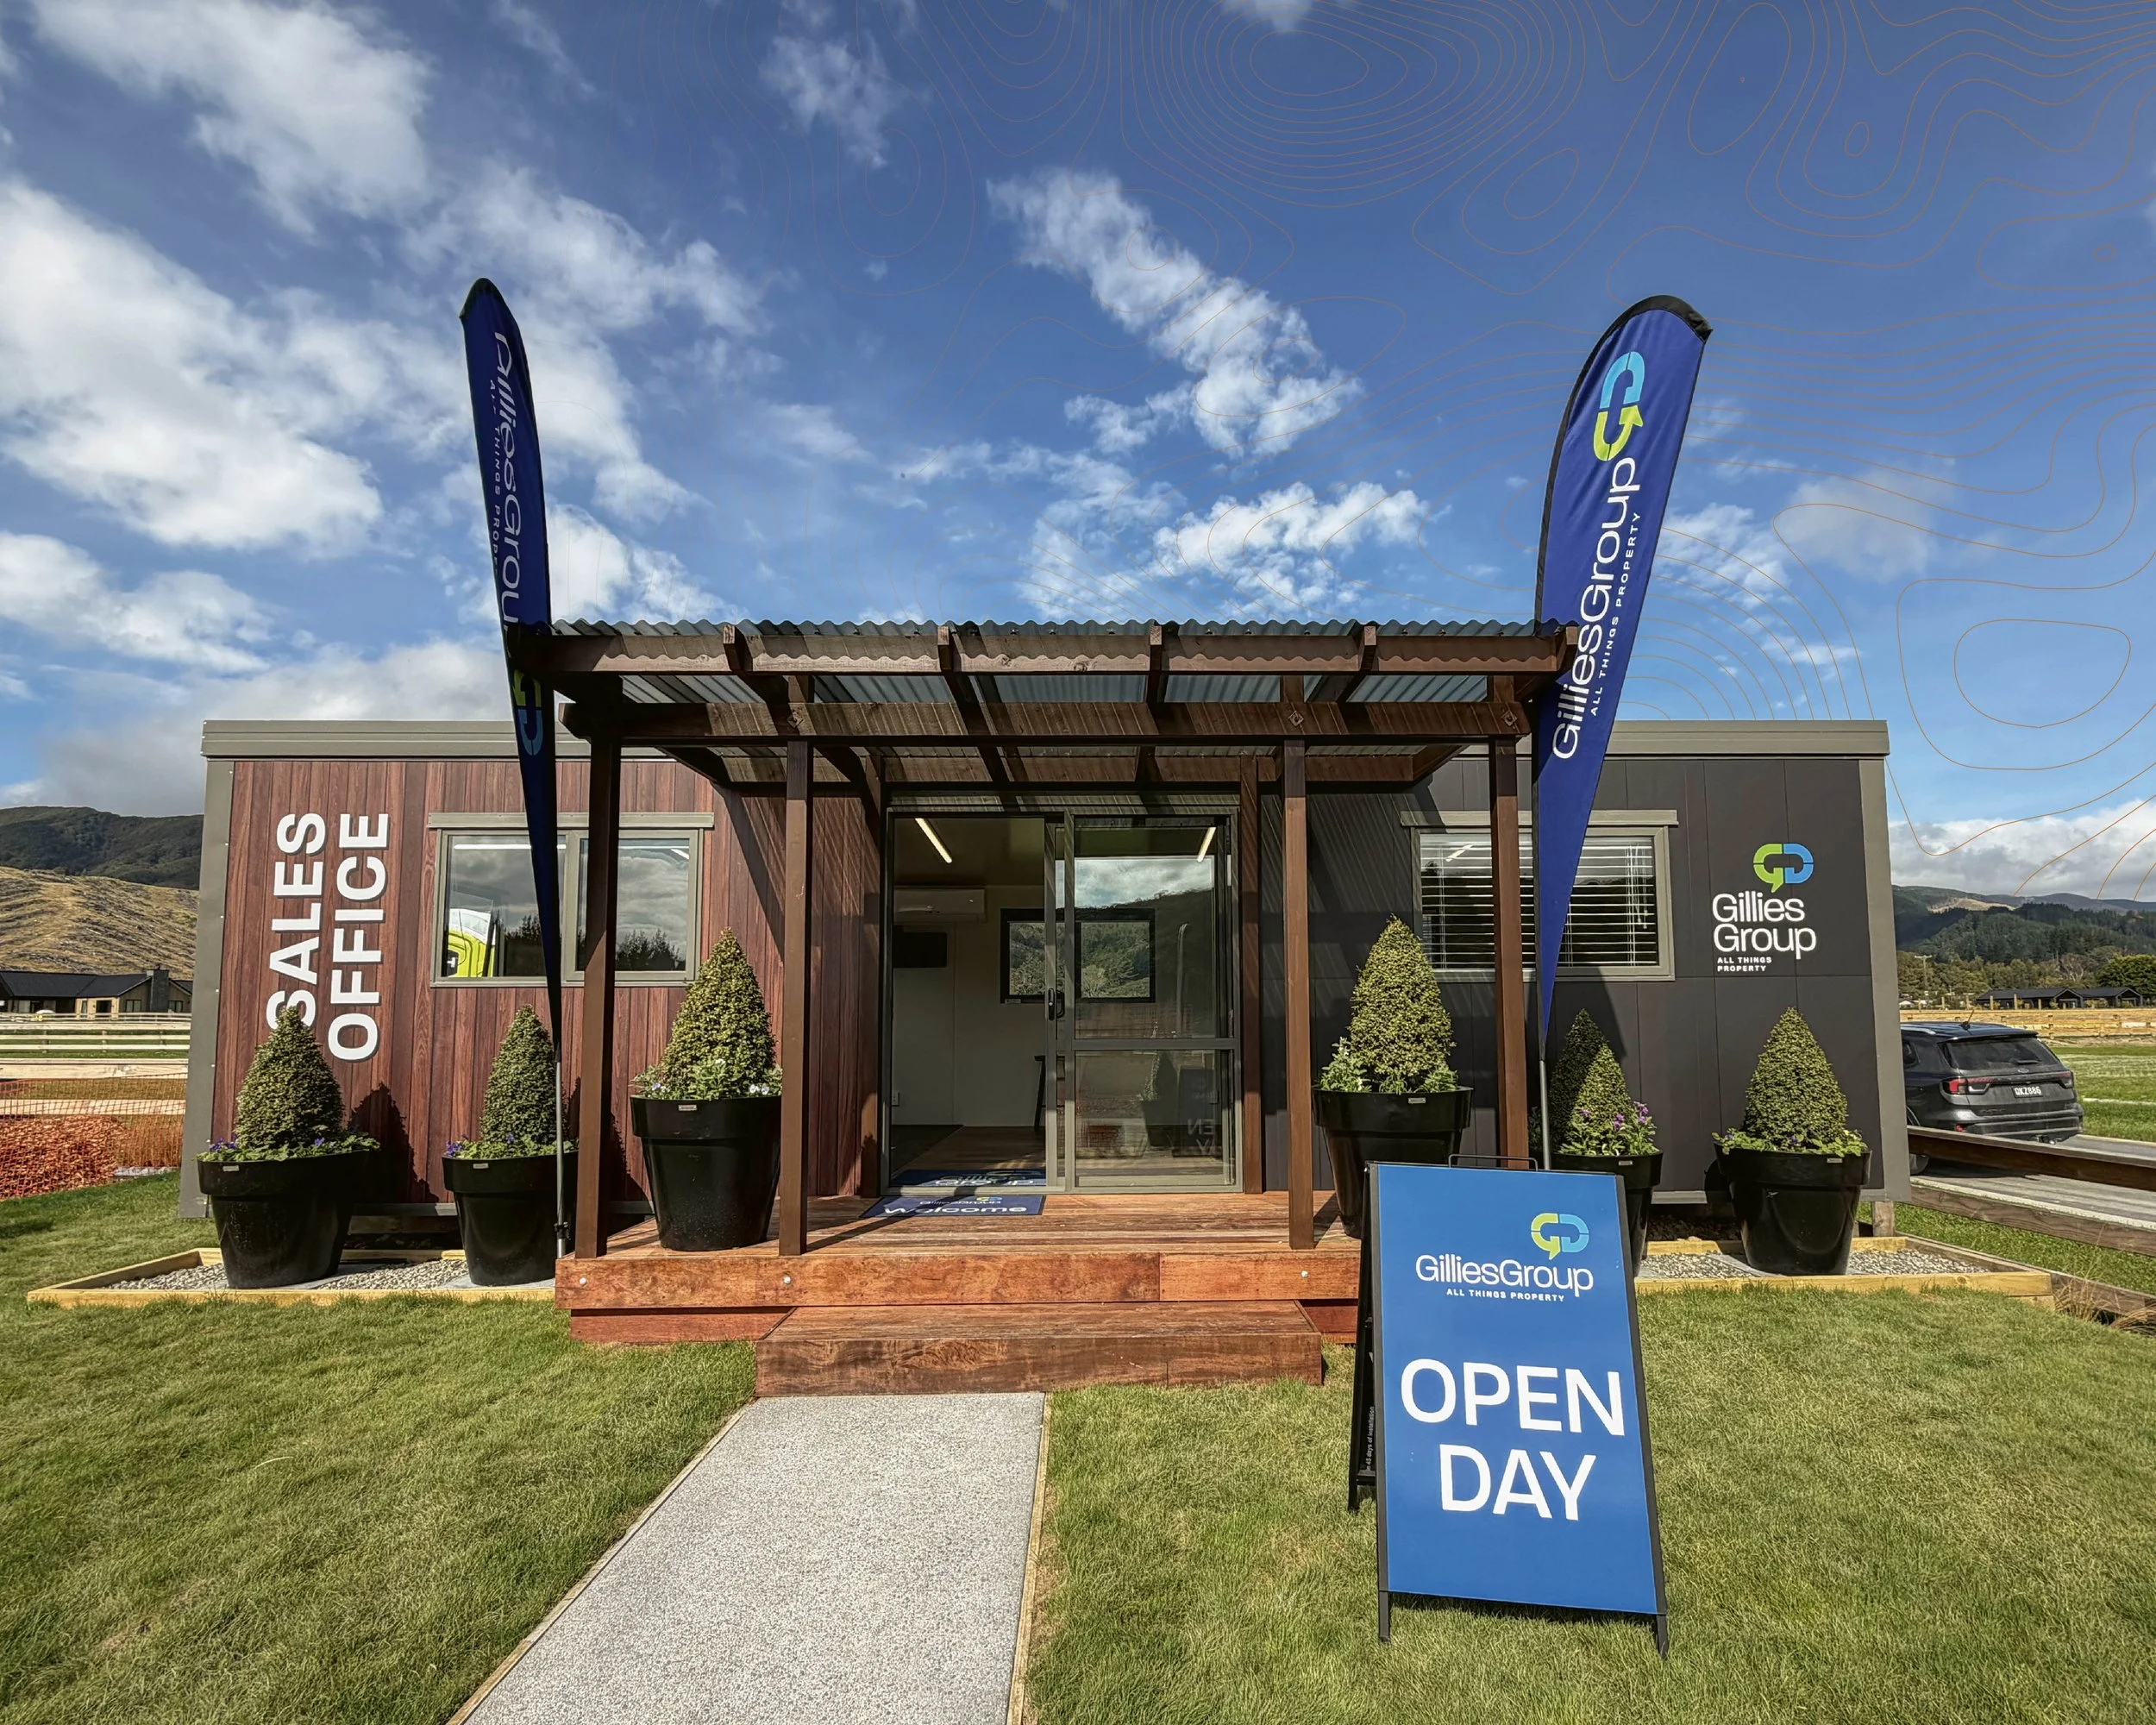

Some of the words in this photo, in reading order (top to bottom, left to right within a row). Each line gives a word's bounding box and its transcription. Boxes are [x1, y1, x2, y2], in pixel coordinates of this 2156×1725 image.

[1552, 457, 1641, 759] GilliesGroup
[1590, 687, 1602, 717] ALL
[1599, 617, 1619, 678] THINGS
[1615, 512, 1641, 607] PROPERTY
[266, 812, 326, 1031] SALES
[328, 812, 389, 1061] OFFICE
[1712, 890, 1805, 923] Gillies
[1713, 923, 1817, 960] Group
[1415, 1253, 1594, 1297] GilliesGroup
[1446, 1288, 1464, 1296] ALL
[1469, 1289, 1506, 1299] THINGS
[1510, 1292, 1564, 1302] PROPERTY
[1401, 1358, 1625, 1436] OPEN
[1439, 1444, 1596, 1521] DAY
